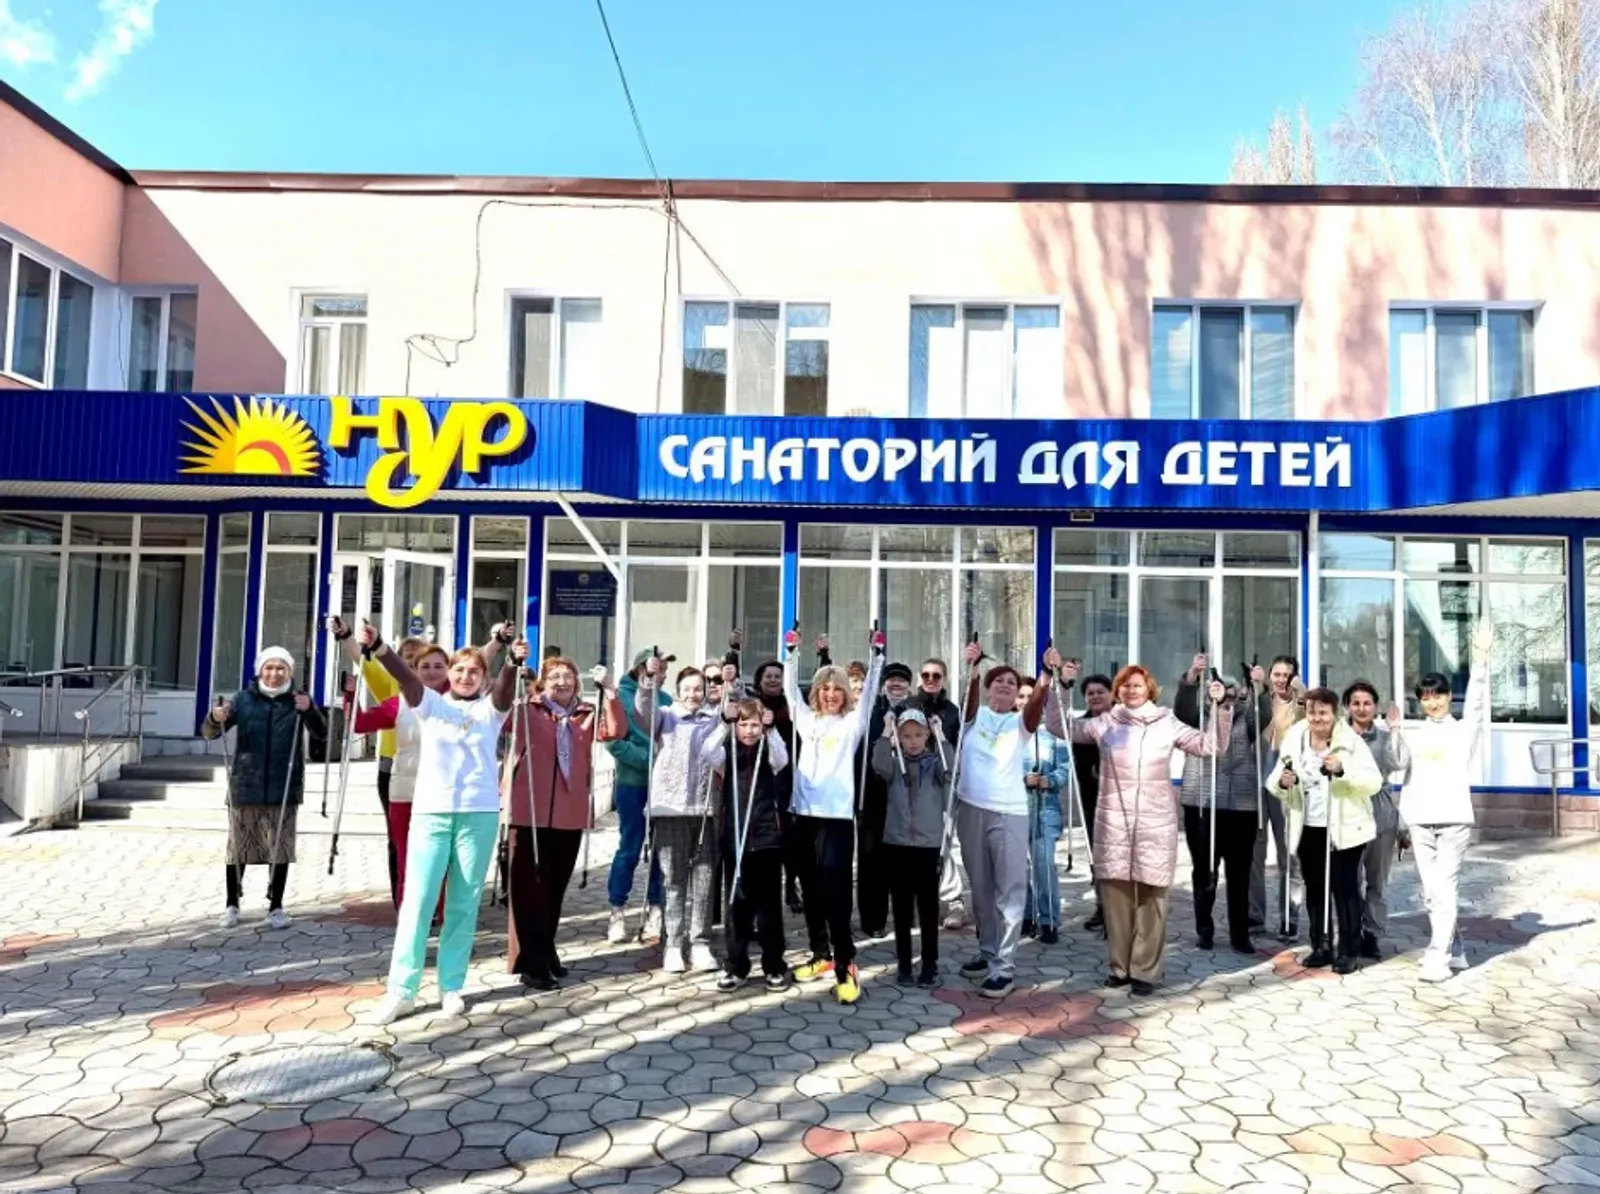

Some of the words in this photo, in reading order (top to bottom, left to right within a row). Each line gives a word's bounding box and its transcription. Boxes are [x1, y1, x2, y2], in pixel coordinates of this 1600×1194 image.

[659, 433, 997, 486] САНАТОРИЙ
[1017, 441, 1141, 490] ДЛЯ
[1160, 436, 1352, 488] ДЕТЕЙ
